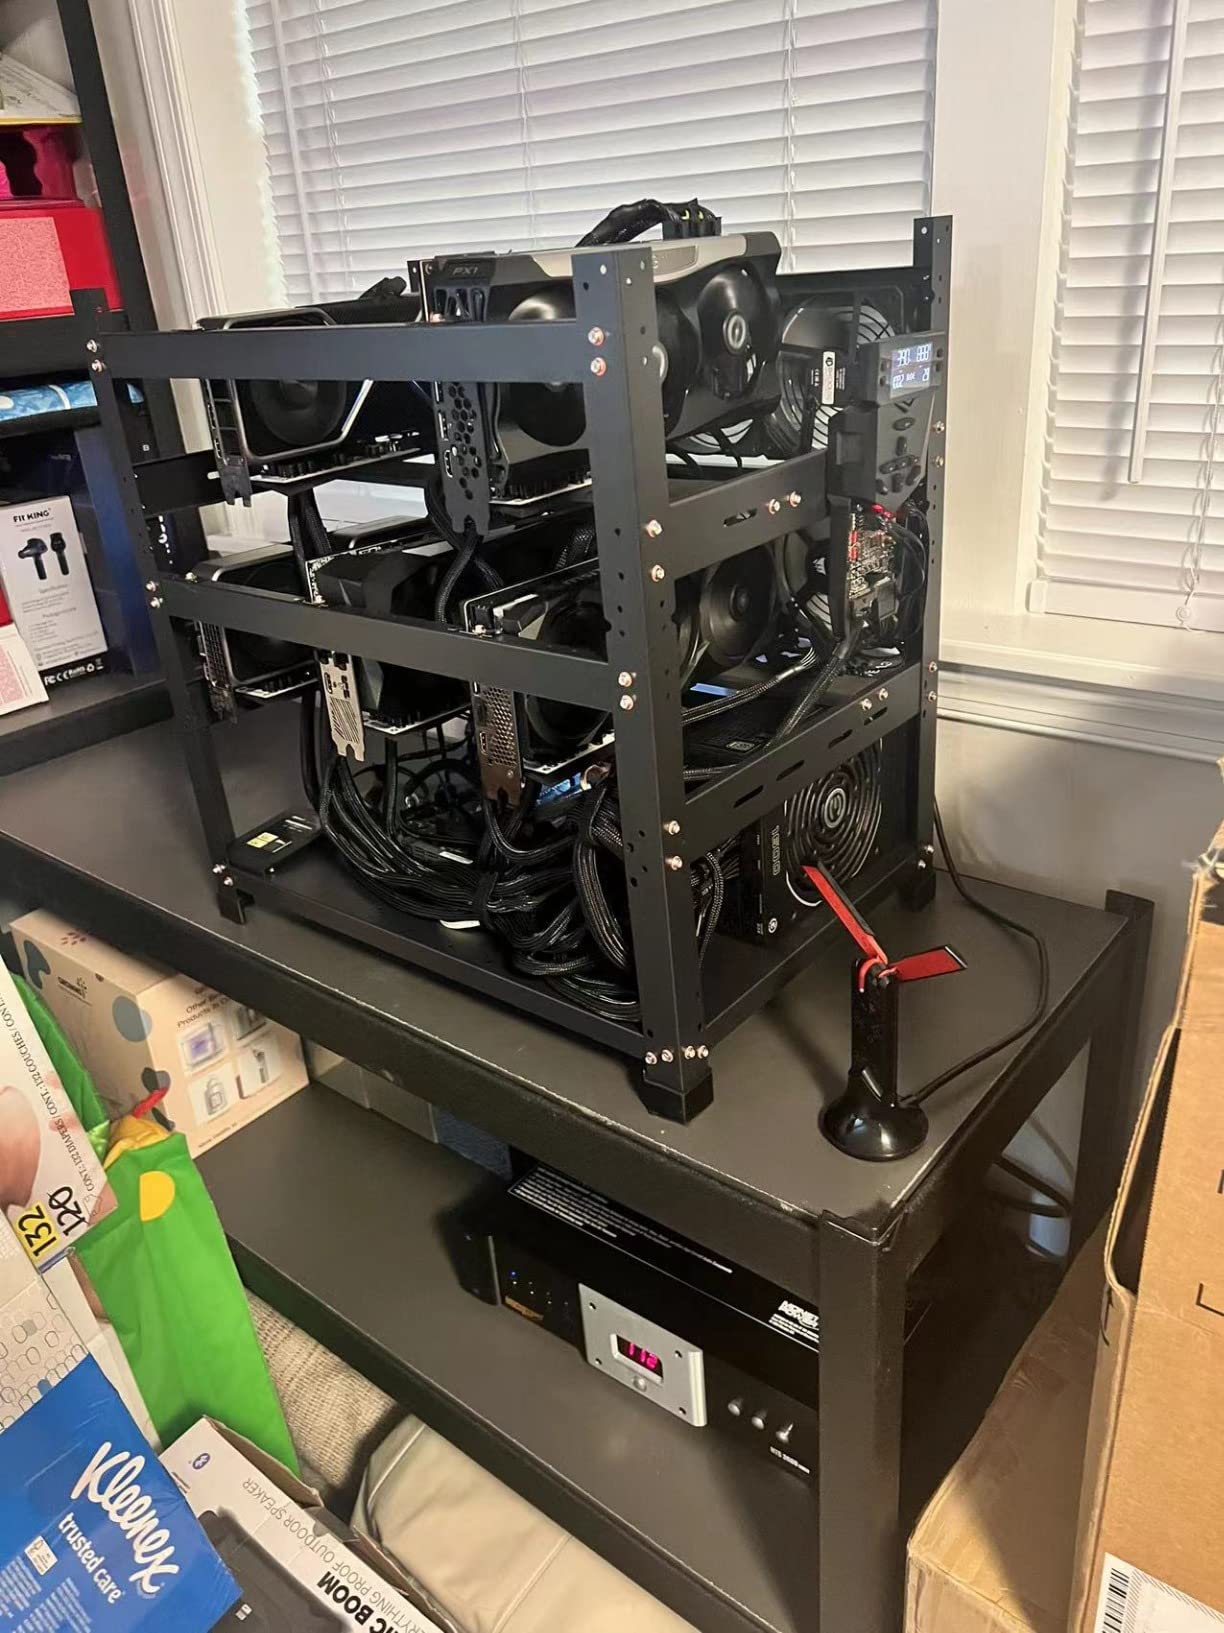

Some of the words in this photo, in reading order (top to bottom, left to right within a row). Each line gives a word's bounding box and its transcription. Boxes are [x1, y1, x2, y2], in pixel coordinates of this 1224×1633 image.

[12, 1031, 38, 1073] COUCHES
[54, 1118, 76, 1153] DIAPERS
[18, 1204, 57, 1257] 132
[70, 1441, 180, 1594] Kleenex
[242, 1478, 287, 1520] SPEAKER
[58, 1512, 105, 1573] trusted
[93, 1567, 123, 1605] care
[283, 1514, 335, 1563] OUTDOOR
[316, 1571, 374, 1626] BOOM
[332, 1561, 372, 1596] PROOF
